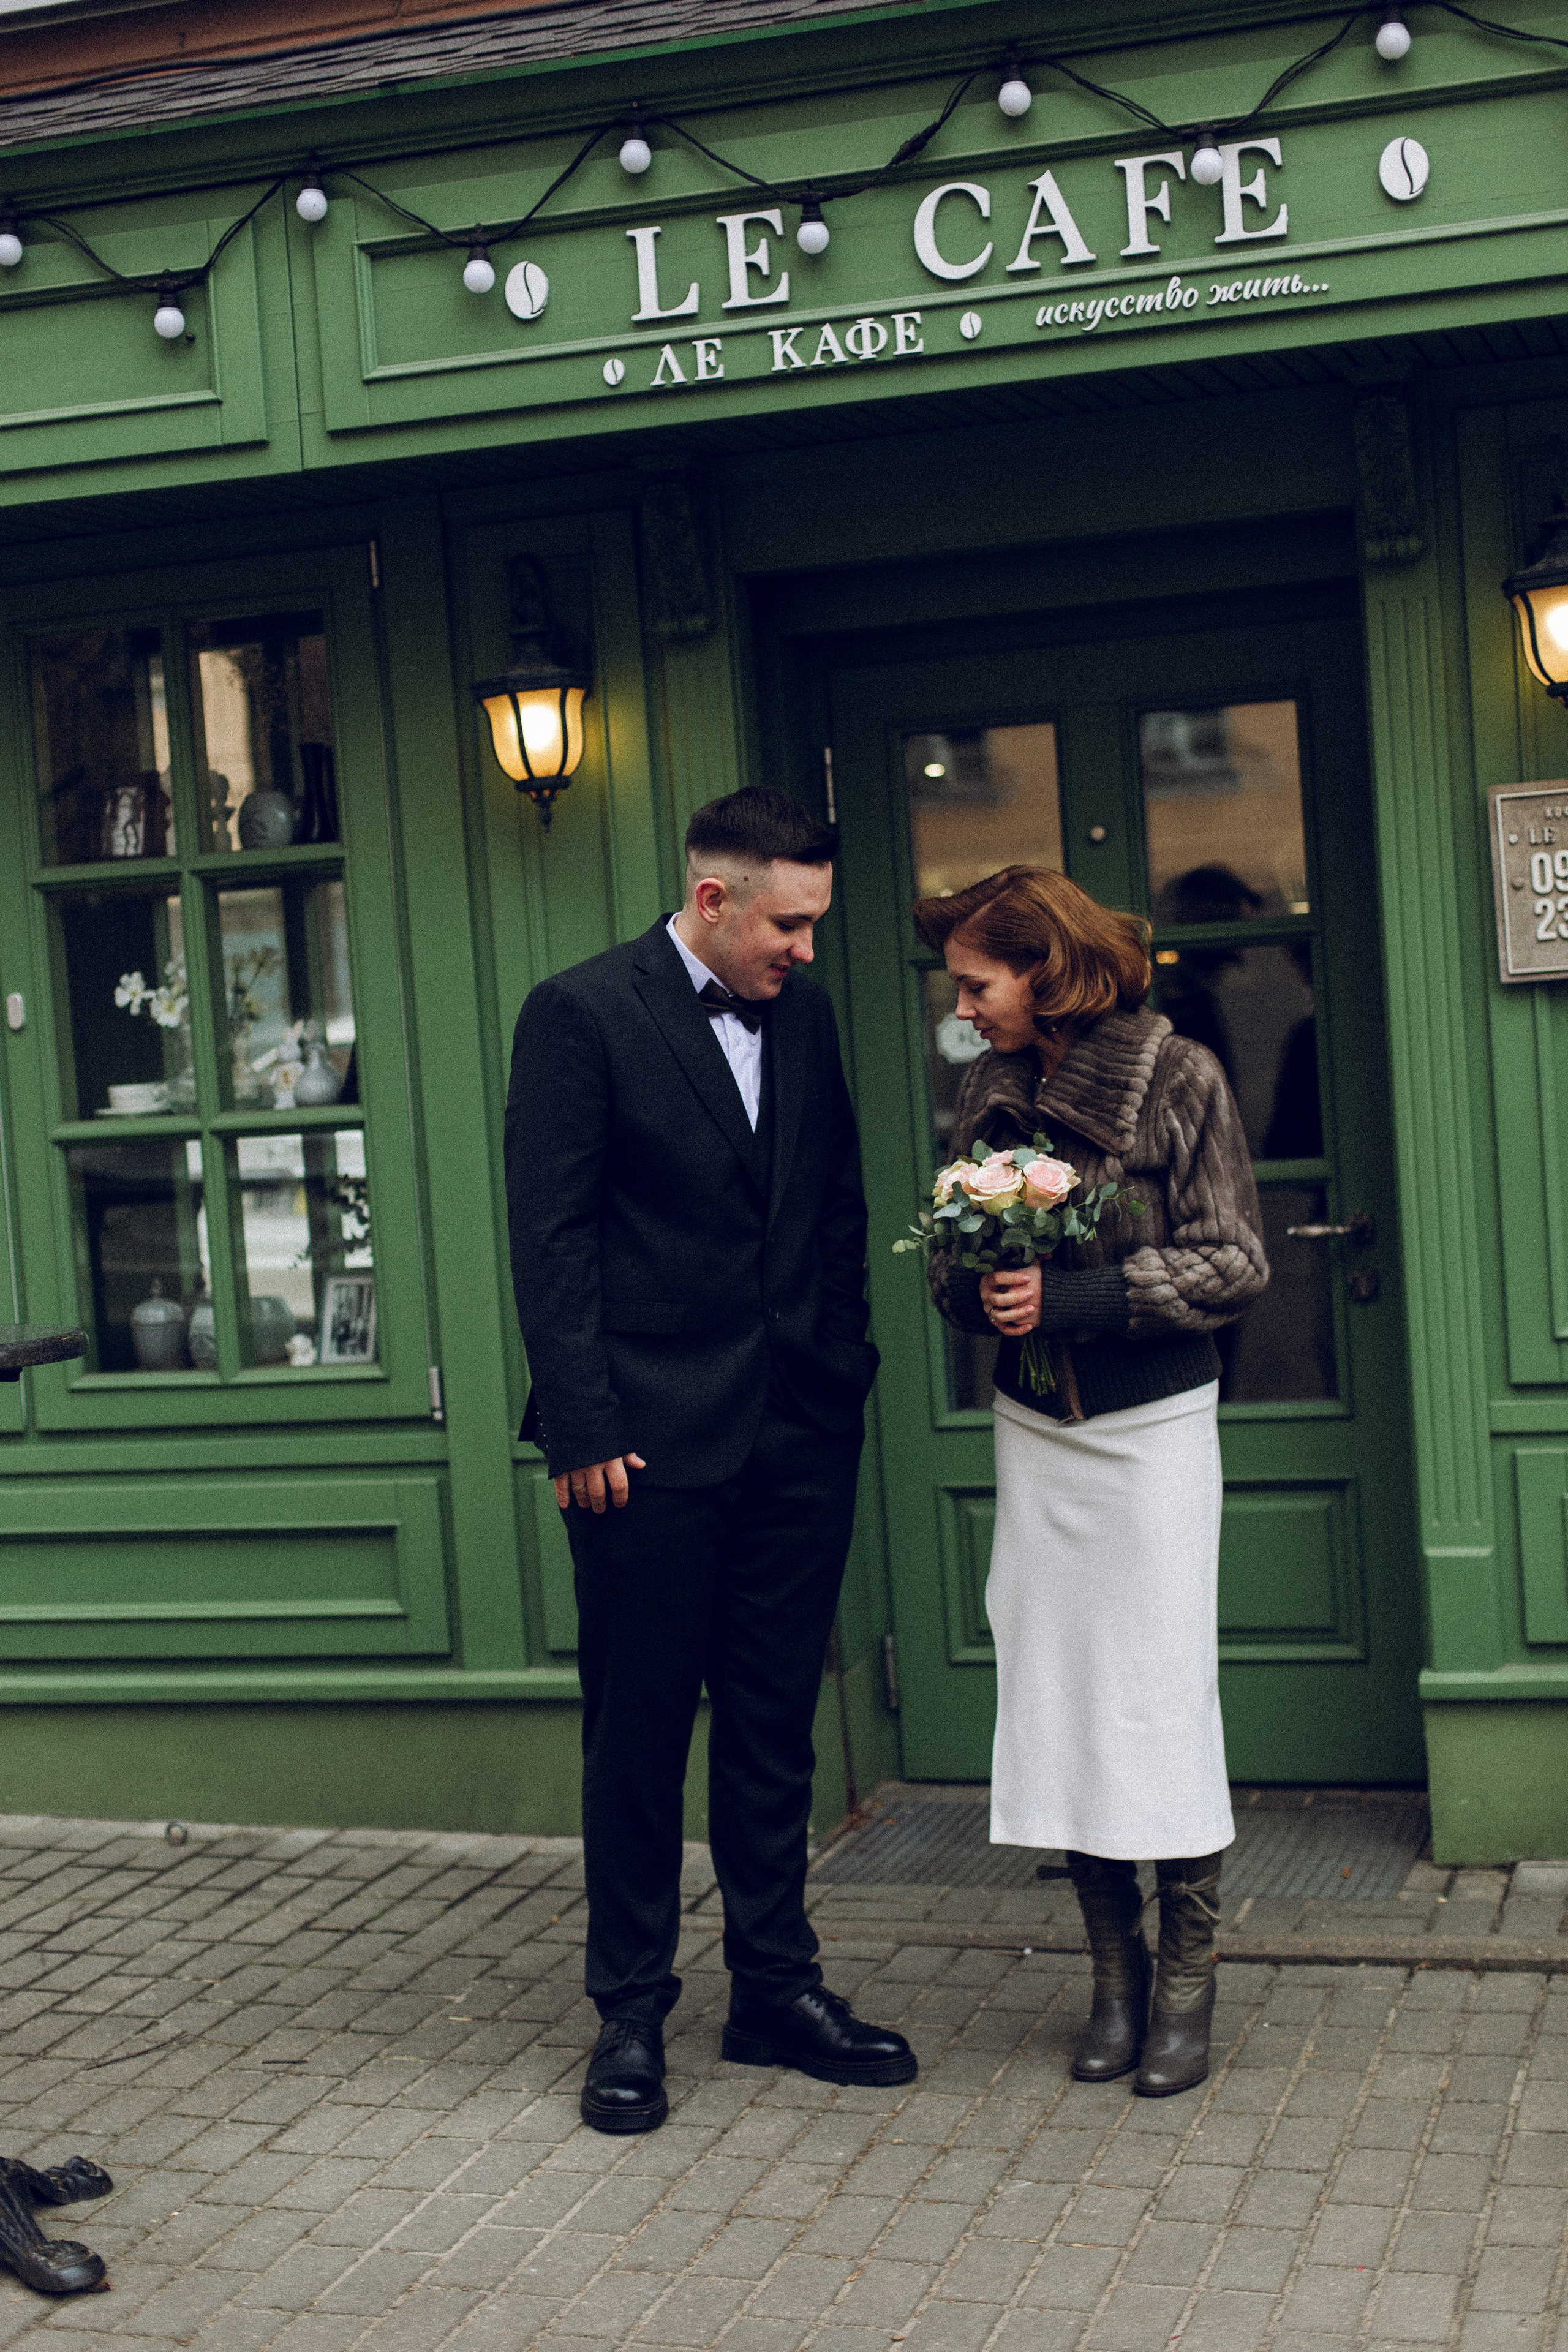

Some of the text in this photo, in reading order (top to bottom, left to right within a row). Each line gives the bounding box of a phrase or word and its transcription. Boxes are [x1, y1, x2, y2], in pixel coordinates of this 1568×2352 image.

[626, 137, 1288, 322] LE CAFE
[1035, 274, 1329, 331] искусство жить...
[650, 312, 924, 386] ЛЕ КАФЕ
